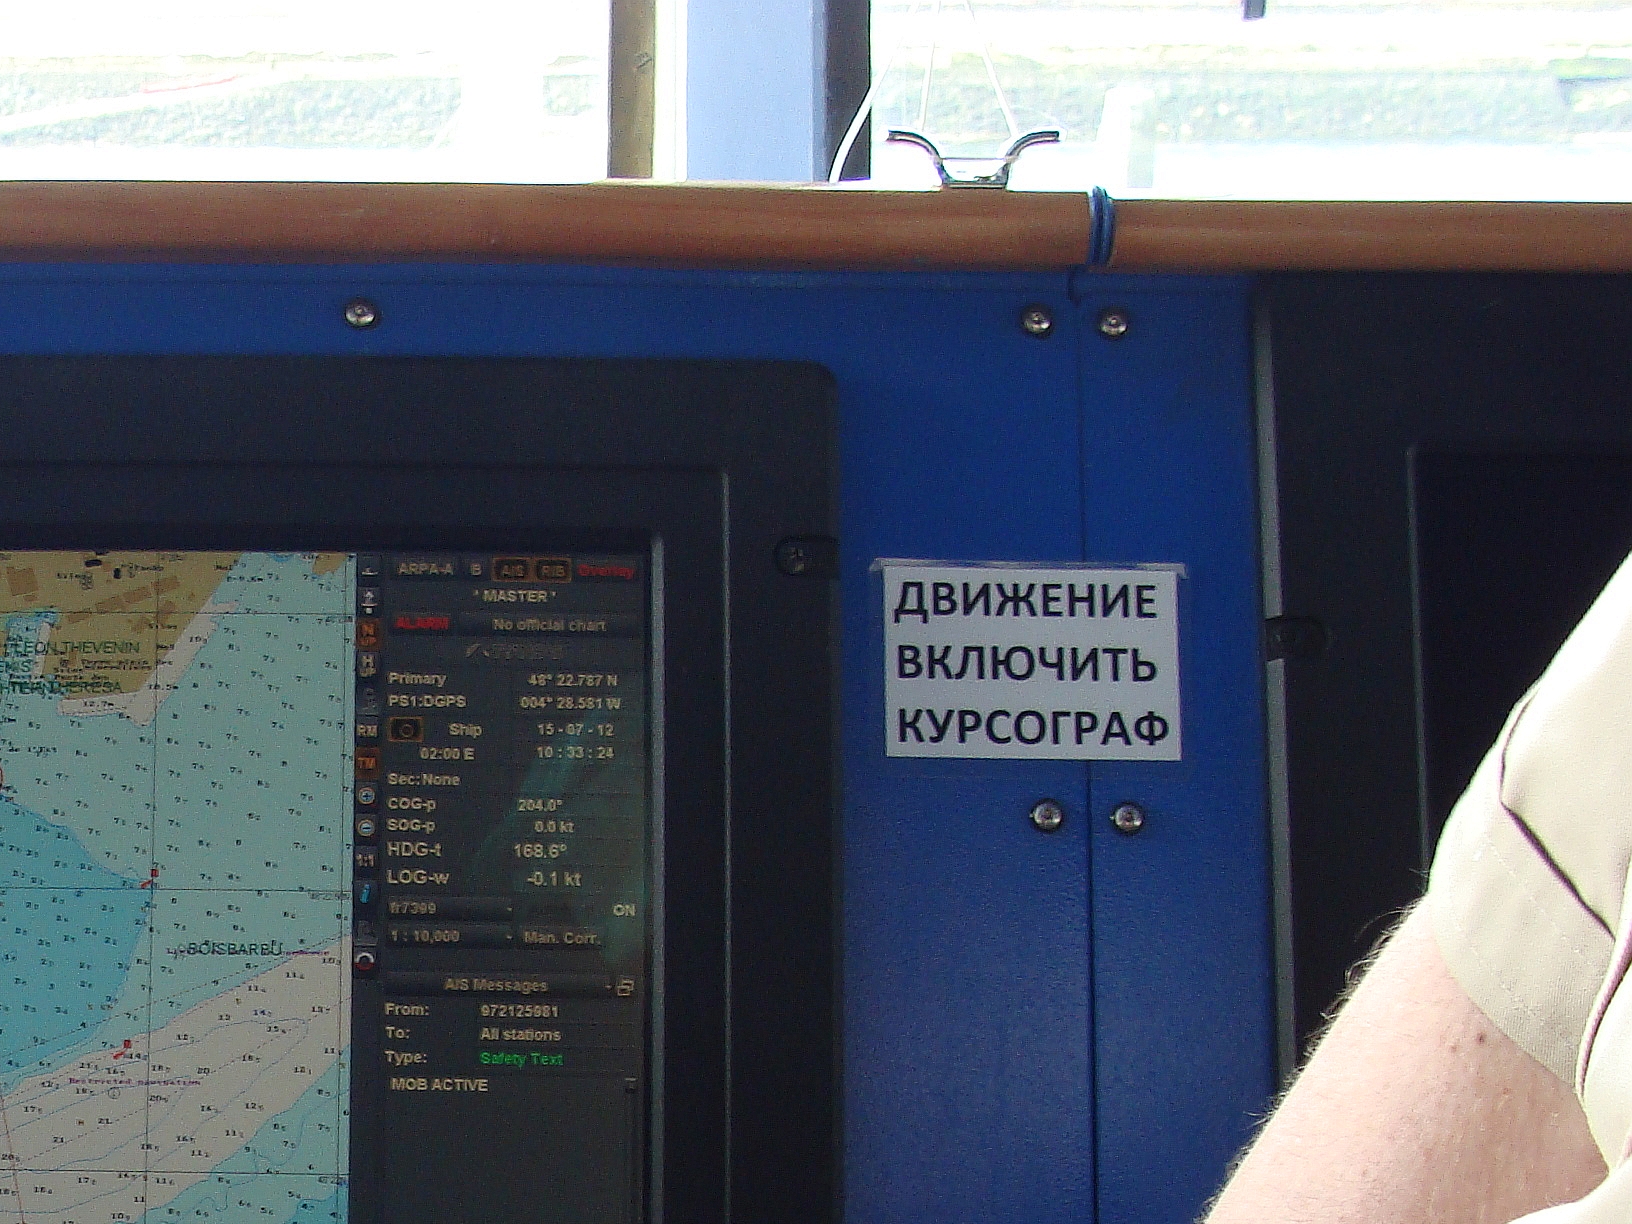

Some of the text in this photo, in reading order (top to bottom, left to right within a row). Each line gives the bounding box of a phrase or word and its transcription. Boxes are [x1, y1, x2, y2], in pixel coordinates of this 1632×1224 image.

[894, 581, 1157, 624] ДВИЖЕНИЕ
[394, 617, 450, 630] ALARM
[493, 619, 513, 631] No
[569, 619, 606, 632] chart
[897, 645, 1158, 682] ВКЛЮЧИТЬ
[387, 672, 446, 687] Primary
[607, 675, 618, 687] N
[387, 695, 466, 708] PS1:DGPS
[607, 697, 621, 710] W
[448, 723, 483, 738] Ship
[898, 708, 1169, 746] КУРСОГРАФ
[464, 748, 475, 760] E
[387, 798, 436, 812] COG-p
[387, 819, 436, 834] SOG-p
[559, 820, 575, 833] kt
[387, 842, 442, 857] HDG-t
[386, 869, 582, 886] LOG-w -0.1 kt
[613, 904, 636, 917] ON
[524, 932, 559, 944] Man.
[563, 932, 601, 944] Corr.
[444, 979, 548, 995] AIS Messages
[385, 1003, 430, 1016] From:
[385, 1027, 561, 1041] To: All stations
[385, 1051, 563, 1068] Type: Safety Text
[390, 1078, 488, 1092] MOB ACTIVE
